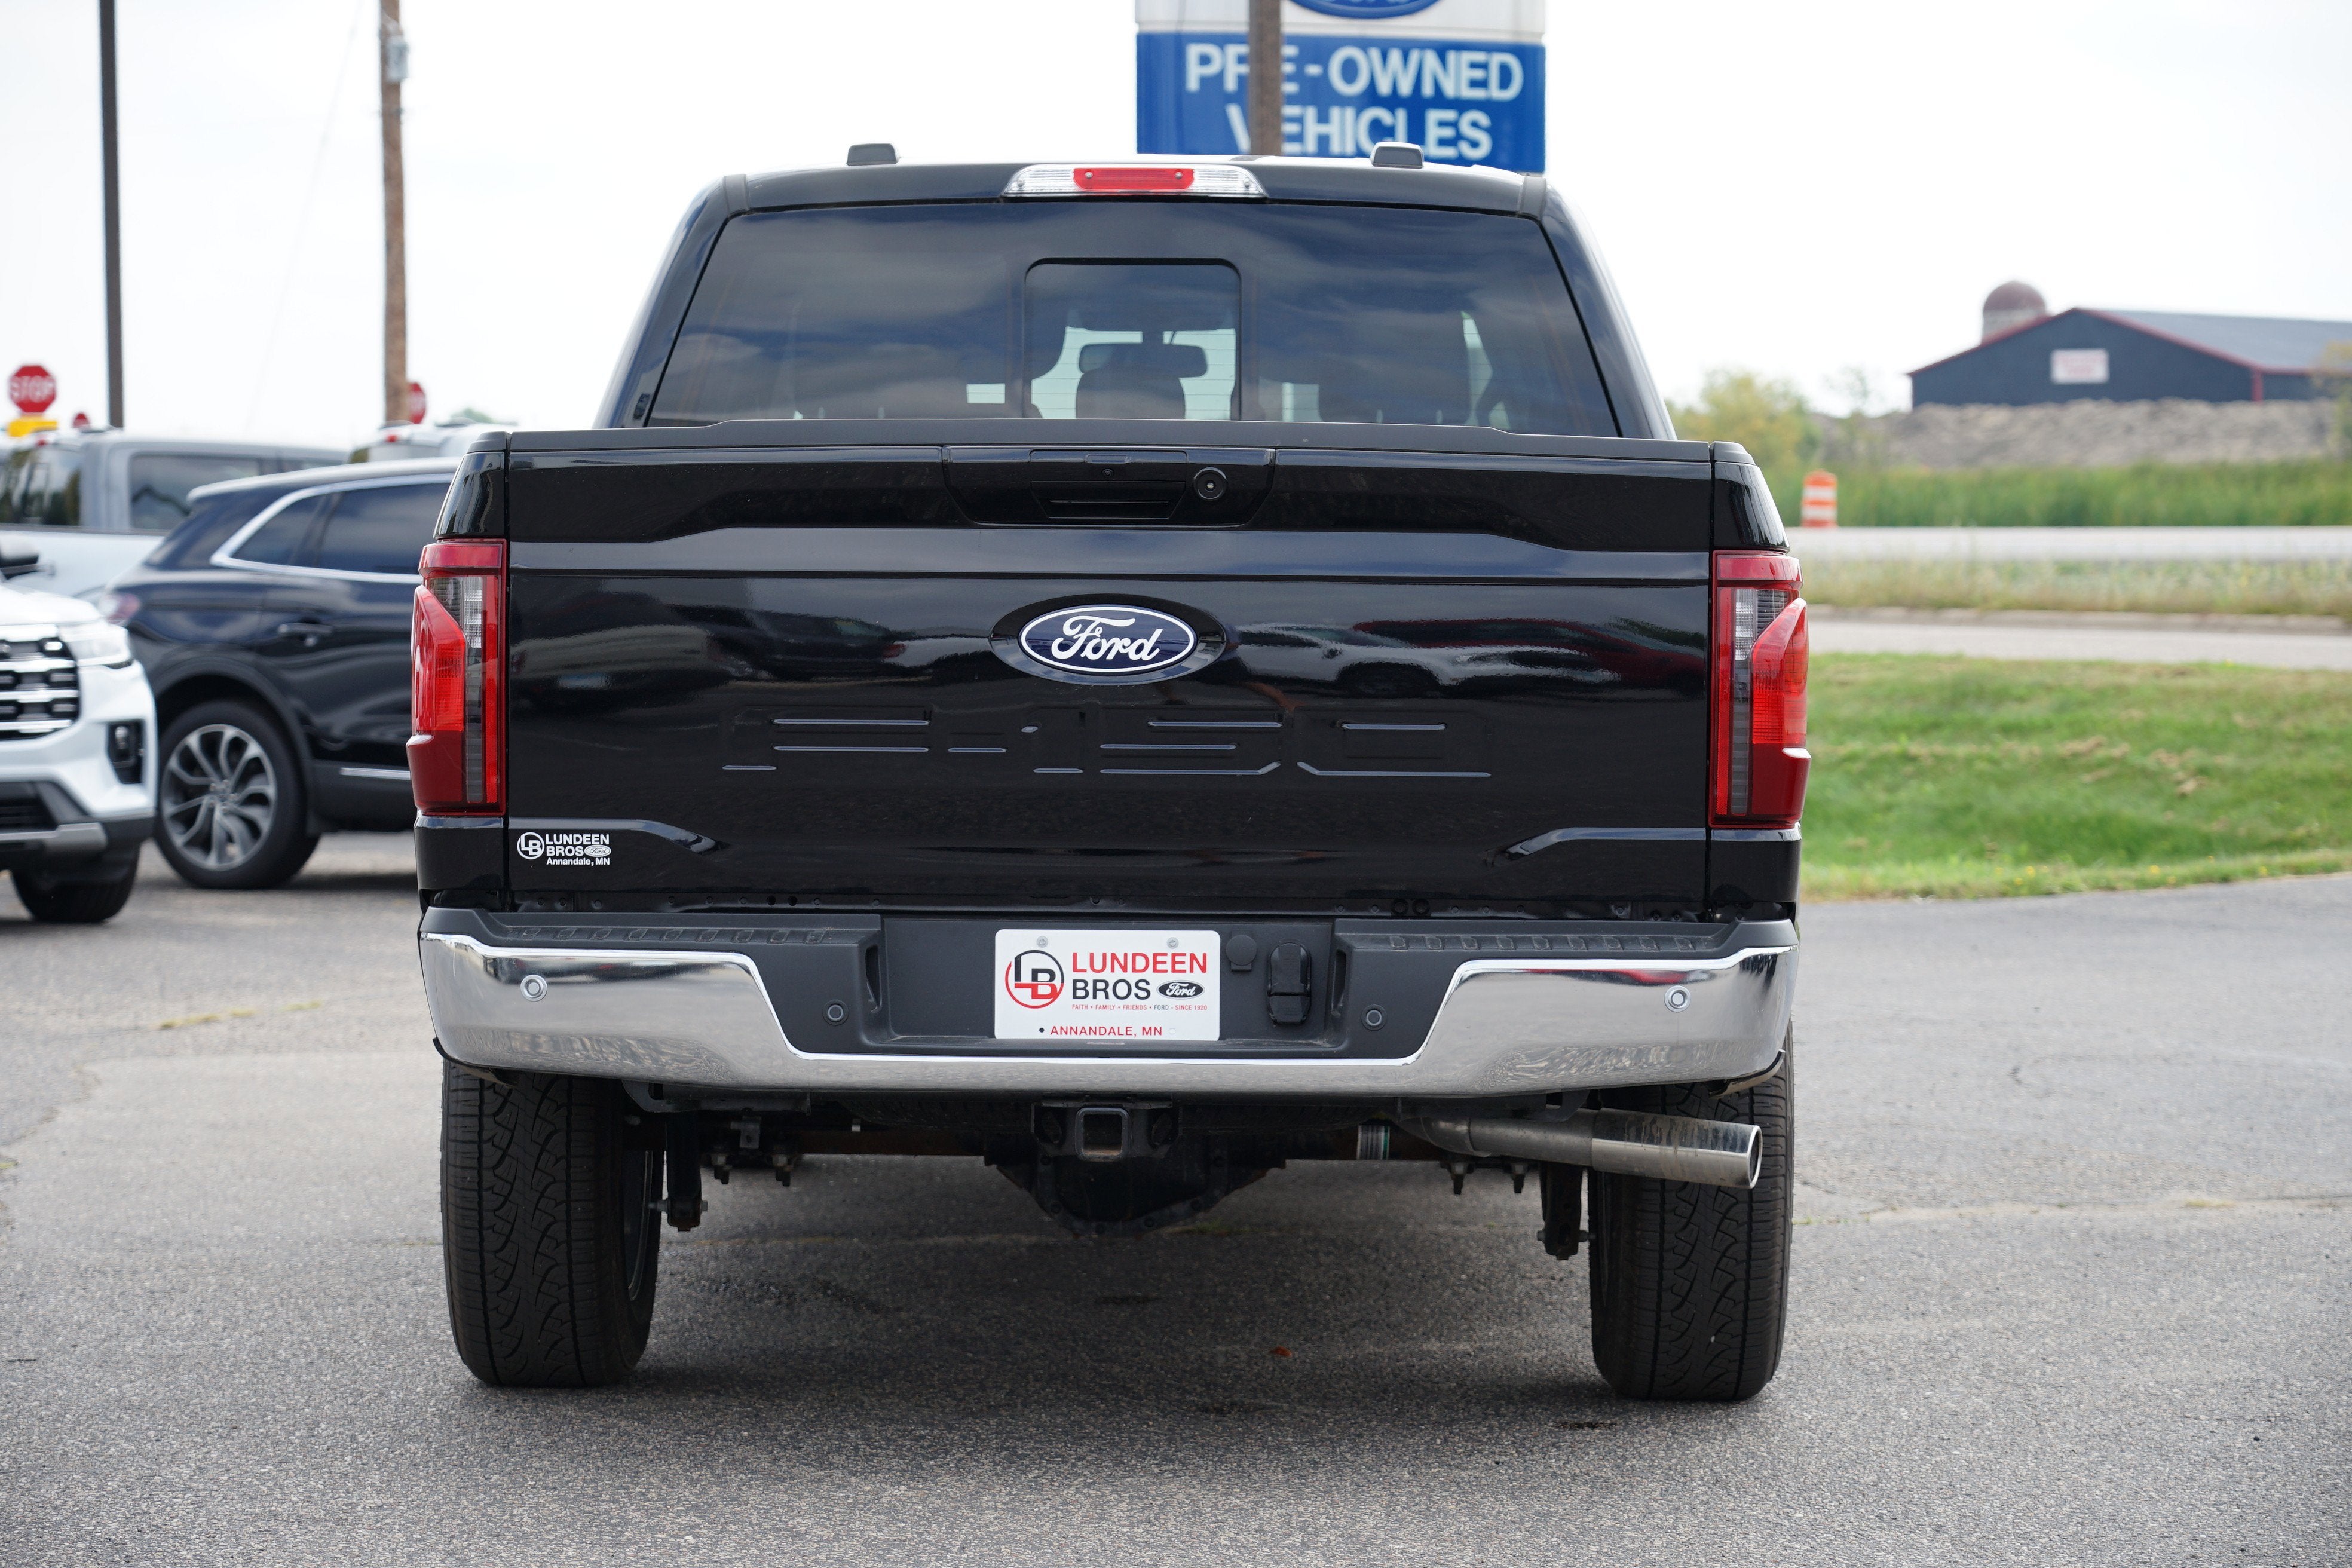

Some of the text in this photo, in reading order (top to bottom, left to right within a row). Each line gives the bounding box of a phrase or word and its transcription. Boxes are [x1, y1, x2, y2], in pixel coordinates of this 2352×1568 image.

[10, 375, 56, 403] STOP
[1051, 615, 1163, 661] Ford
[545, 834, 610, 844] LUNDEEN
[546, 846, 584, 856] BROS
[546, 858, 594, 866] Annandale,
[1072, 952, 1208, 973] LUNDEEN
[1072, 978, 1196, 1000] BROS Ford
[1050, 1025, 1162, 1038] ANNANDALE, MN
